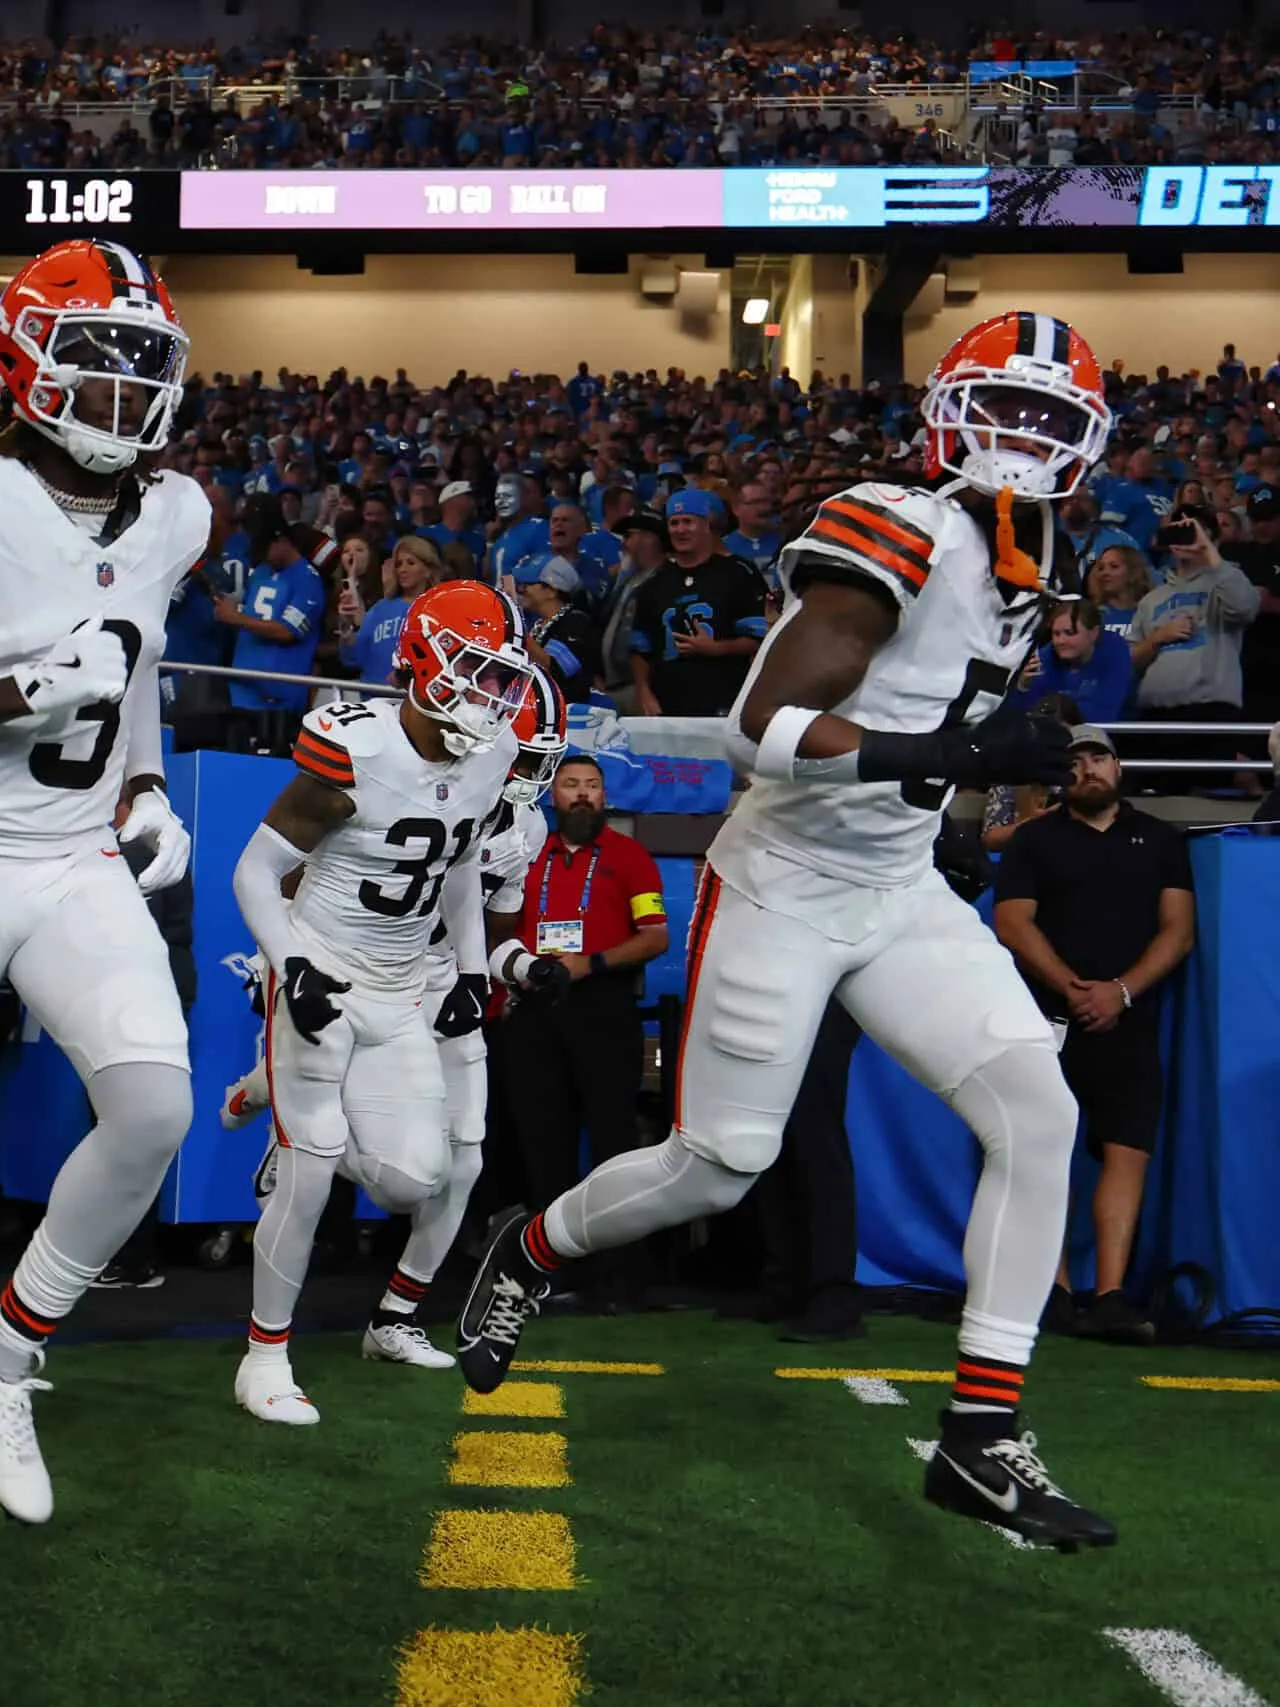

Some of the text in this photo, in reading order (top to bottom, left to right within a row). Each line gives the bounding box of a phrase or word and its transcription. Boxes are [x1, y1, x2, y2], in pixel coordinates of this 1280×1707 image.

[25, 180, 133, 223] 11:02
[424, 185, 492, 214] TO GO
[509, 185, 607, 214] BALL ON
[253, 586, 278, 621] 5
[325, 703, 377, 727] 31
[360, 817, 476, 917] 31
